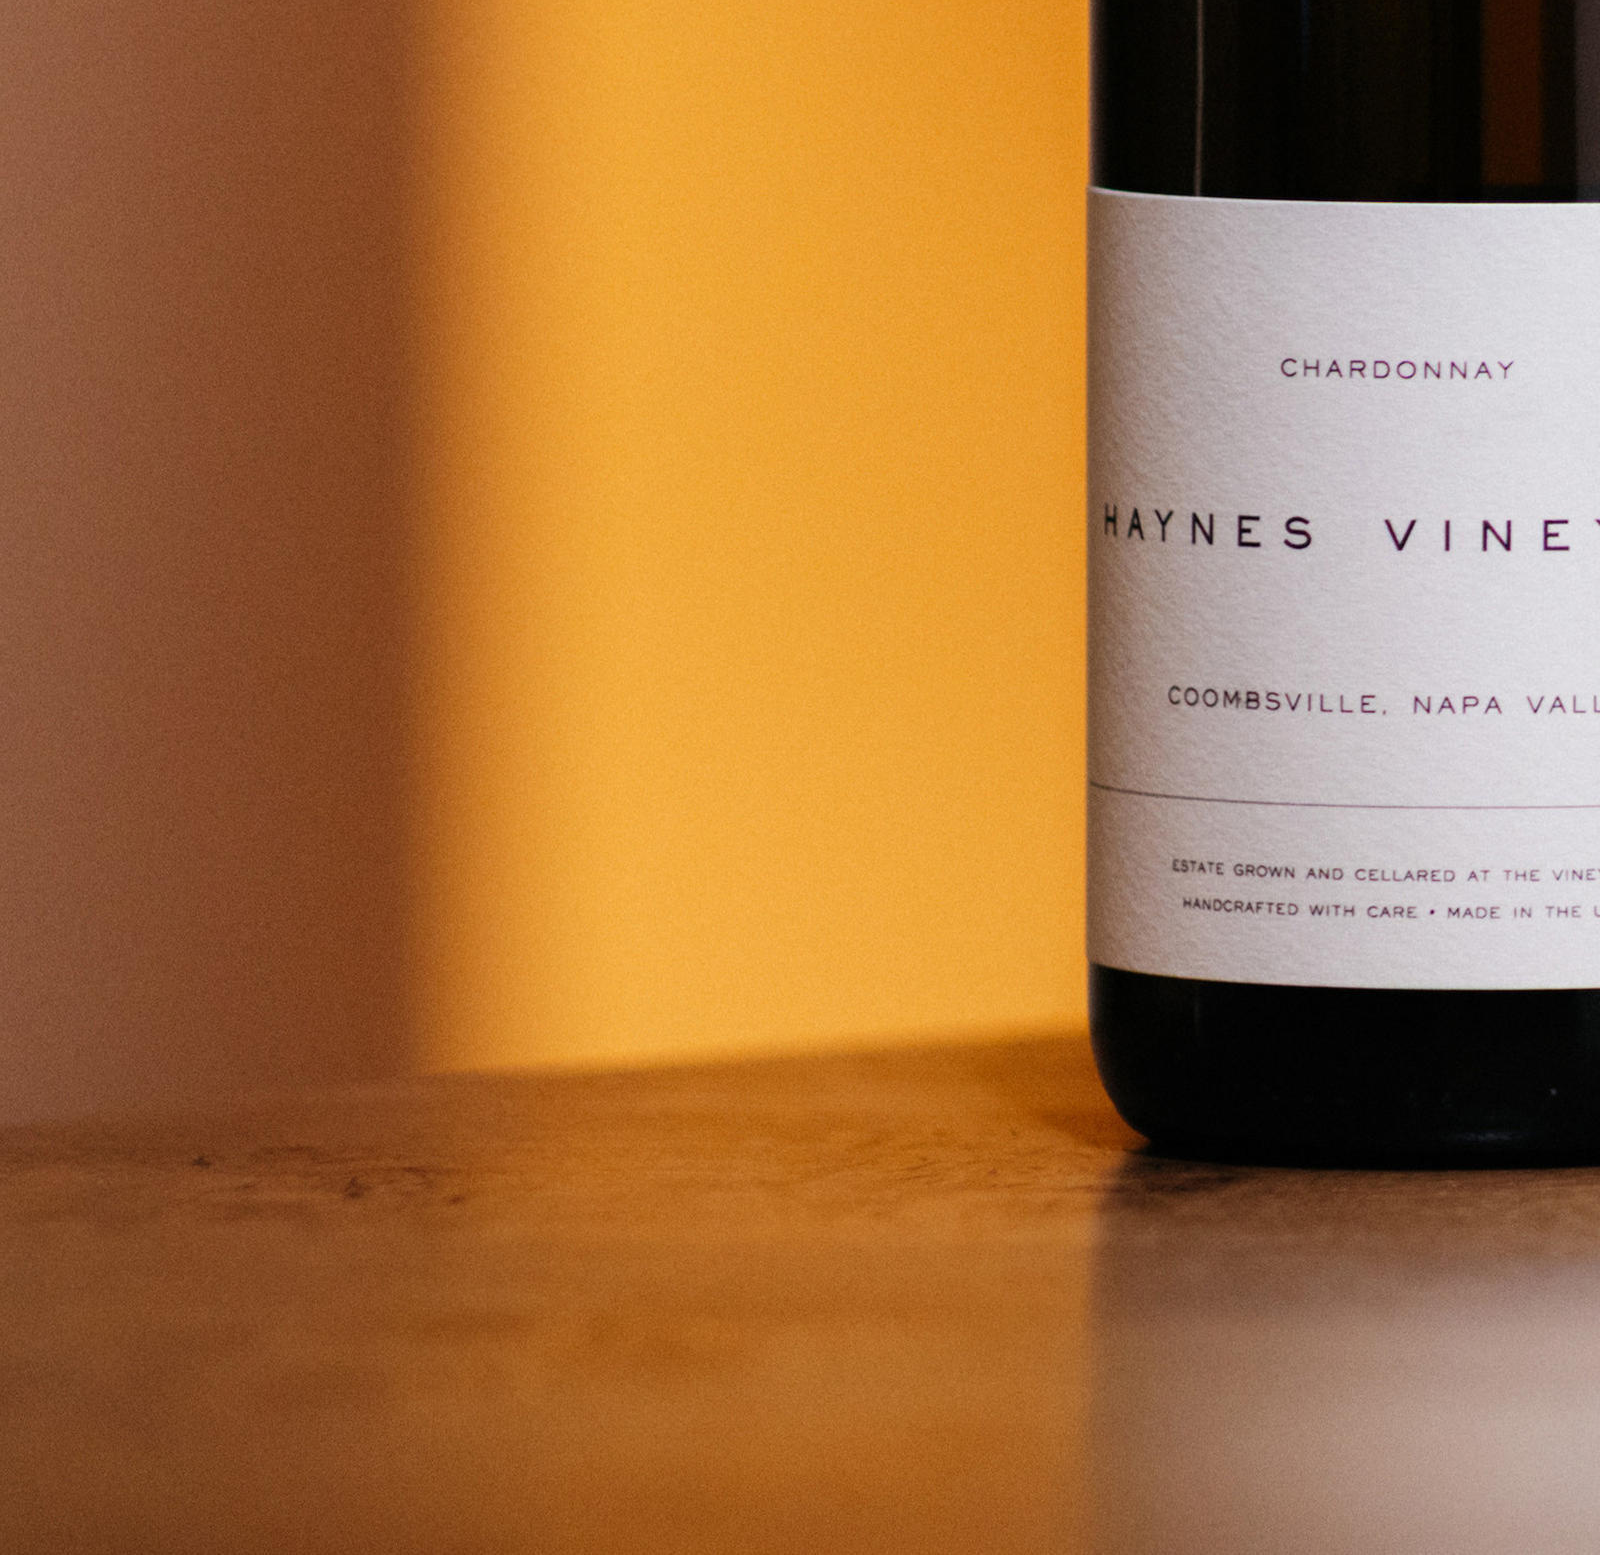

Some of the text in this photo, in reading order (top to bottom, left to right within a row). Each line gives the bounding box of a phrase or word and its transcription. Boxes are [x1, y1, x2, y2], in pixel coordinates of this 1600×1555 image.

[1280, 357, 1516, 381] CHARDONNAY
[1103, 504, 1313, 549] HAYNES
[1167, 685, 1388, 717] COOMBSVILLE,
[1412, 695, 1502, 715] NAPA
[1172, 859, 1224, 875] ESTATE
[1233, 864, 1296, 878] GROWN
[1306, 867, 1343, 881] AND
[1354, 868, 1456, 883] CELLARED
[1467, 869, 1492, 883] AT
[1503, 868, 1540, 882] THE
[1182, 897, 1299, 916] HANDCRAFTED
[1310, 903, 1355, 918] WITH
[1367, 905, 1418, 919] CARE
[1447, 905, 1500, 919] MADE
[1514, 905, 1532, 919] IN
[1545, 904, 1582, 919] THE
